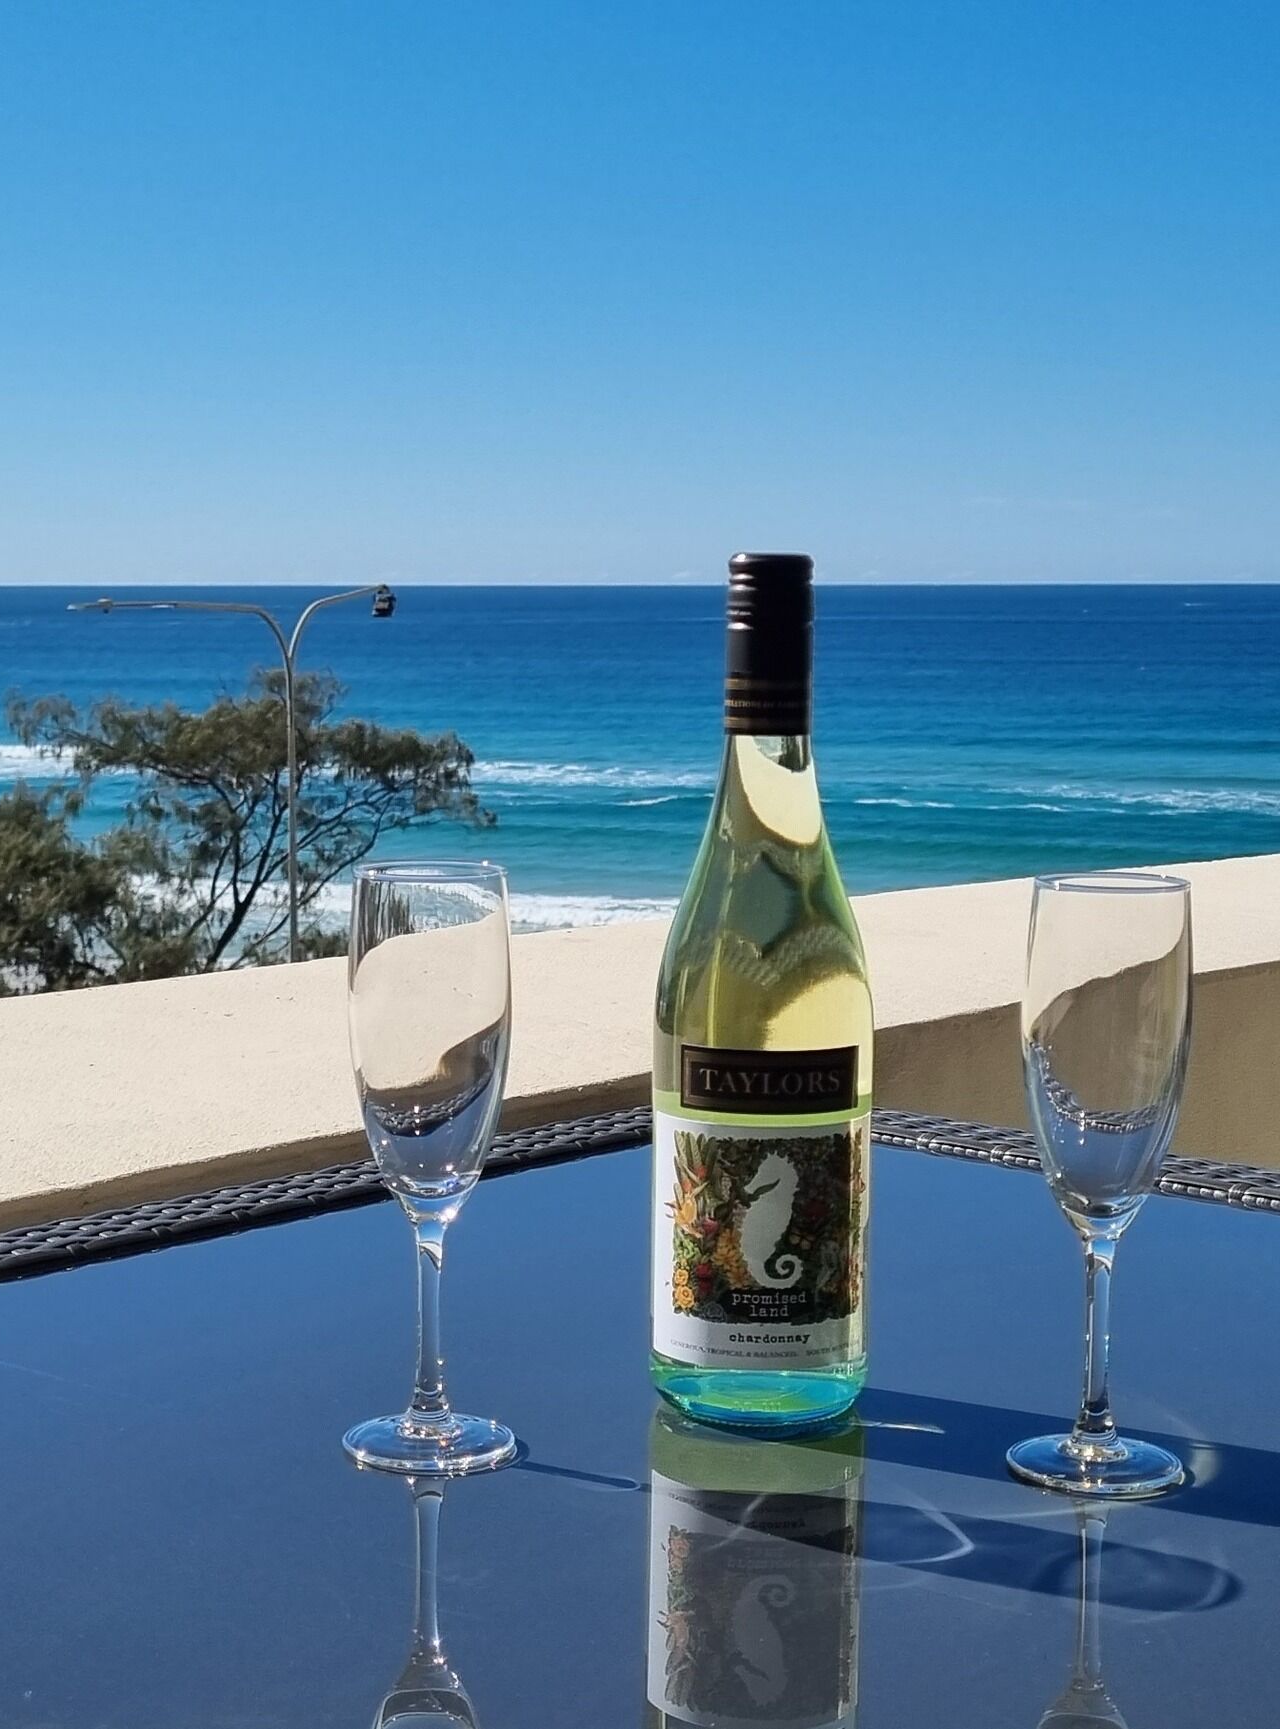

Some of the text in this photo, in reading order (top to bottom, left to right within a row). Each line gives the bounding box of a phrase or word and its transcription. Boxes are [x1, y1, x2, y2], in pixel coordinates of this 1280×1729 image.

[699, 1068, 841, 1095] TAYLORS
[731, 1291, 807, 1305] promised
[749, 1305, 789, 1316] land
[729, 1333, 811, 1344] chardonnay
